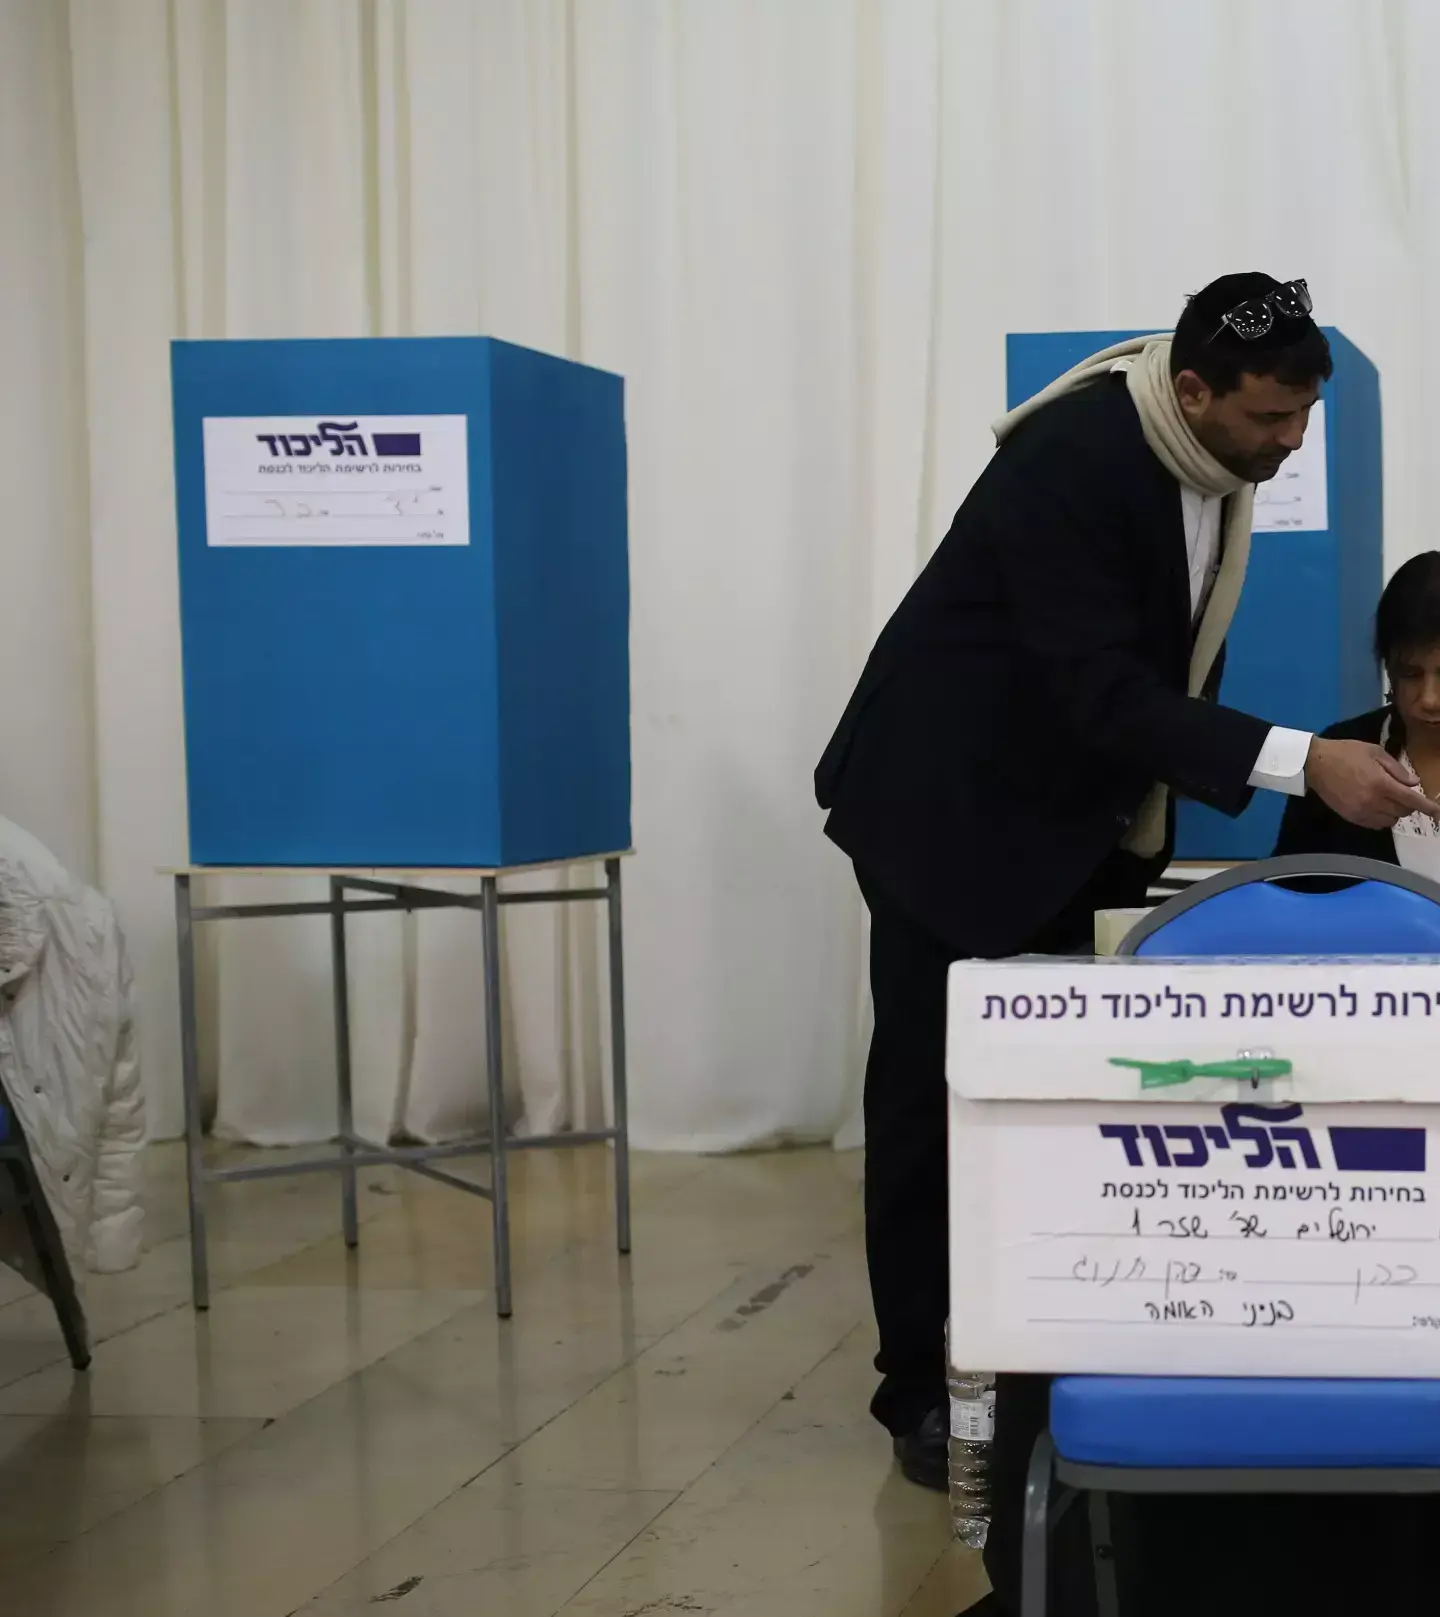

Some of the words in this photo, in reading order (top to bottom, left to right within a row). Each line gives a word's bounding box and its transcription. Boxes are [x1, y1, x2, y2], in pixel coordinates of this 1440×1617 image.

[256, 421, 369, 457] הליכוד
[982, 986, 1086, 1019] לכנסת
[1102, 985, 1206, 1018] הליכוד
[1220, 984, 1357, 1018] לרשימת
[1098, 1102, 1322, 1170] הליכוד
[1101, 1179, 1168, 1199] לכנסת
[1177, 1181, 1244, 1201] הליכוד
[1255, 1183, 1341, 1202] לרשימת
[1350, 1187, 1426, 1203] בחירות
